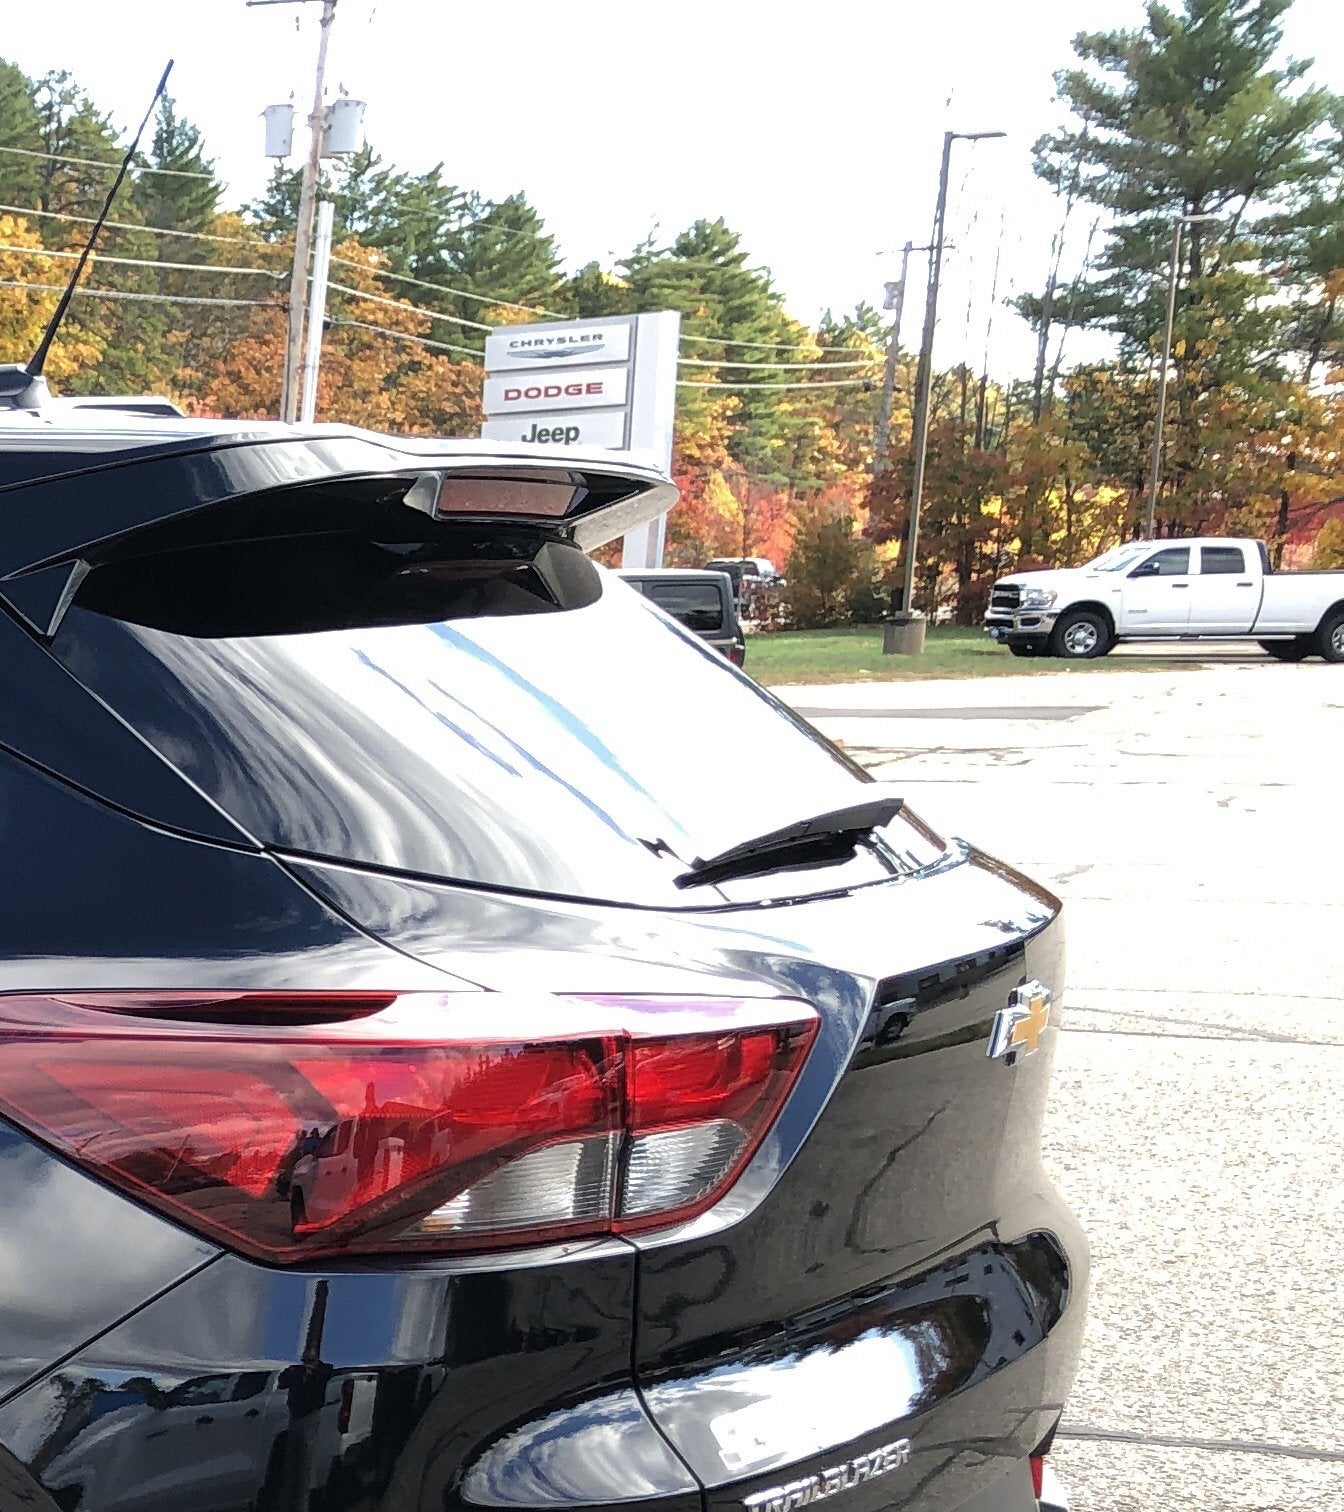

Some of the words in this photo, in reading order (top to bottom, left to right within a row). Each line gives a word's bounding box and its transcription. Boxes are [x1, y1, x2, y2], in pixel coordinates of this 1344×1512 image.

[509, 333, 604, 348] CHRYSLER
[503, 382, 604, 402] DODGE
[520, 423, 581, 446] Jeep
